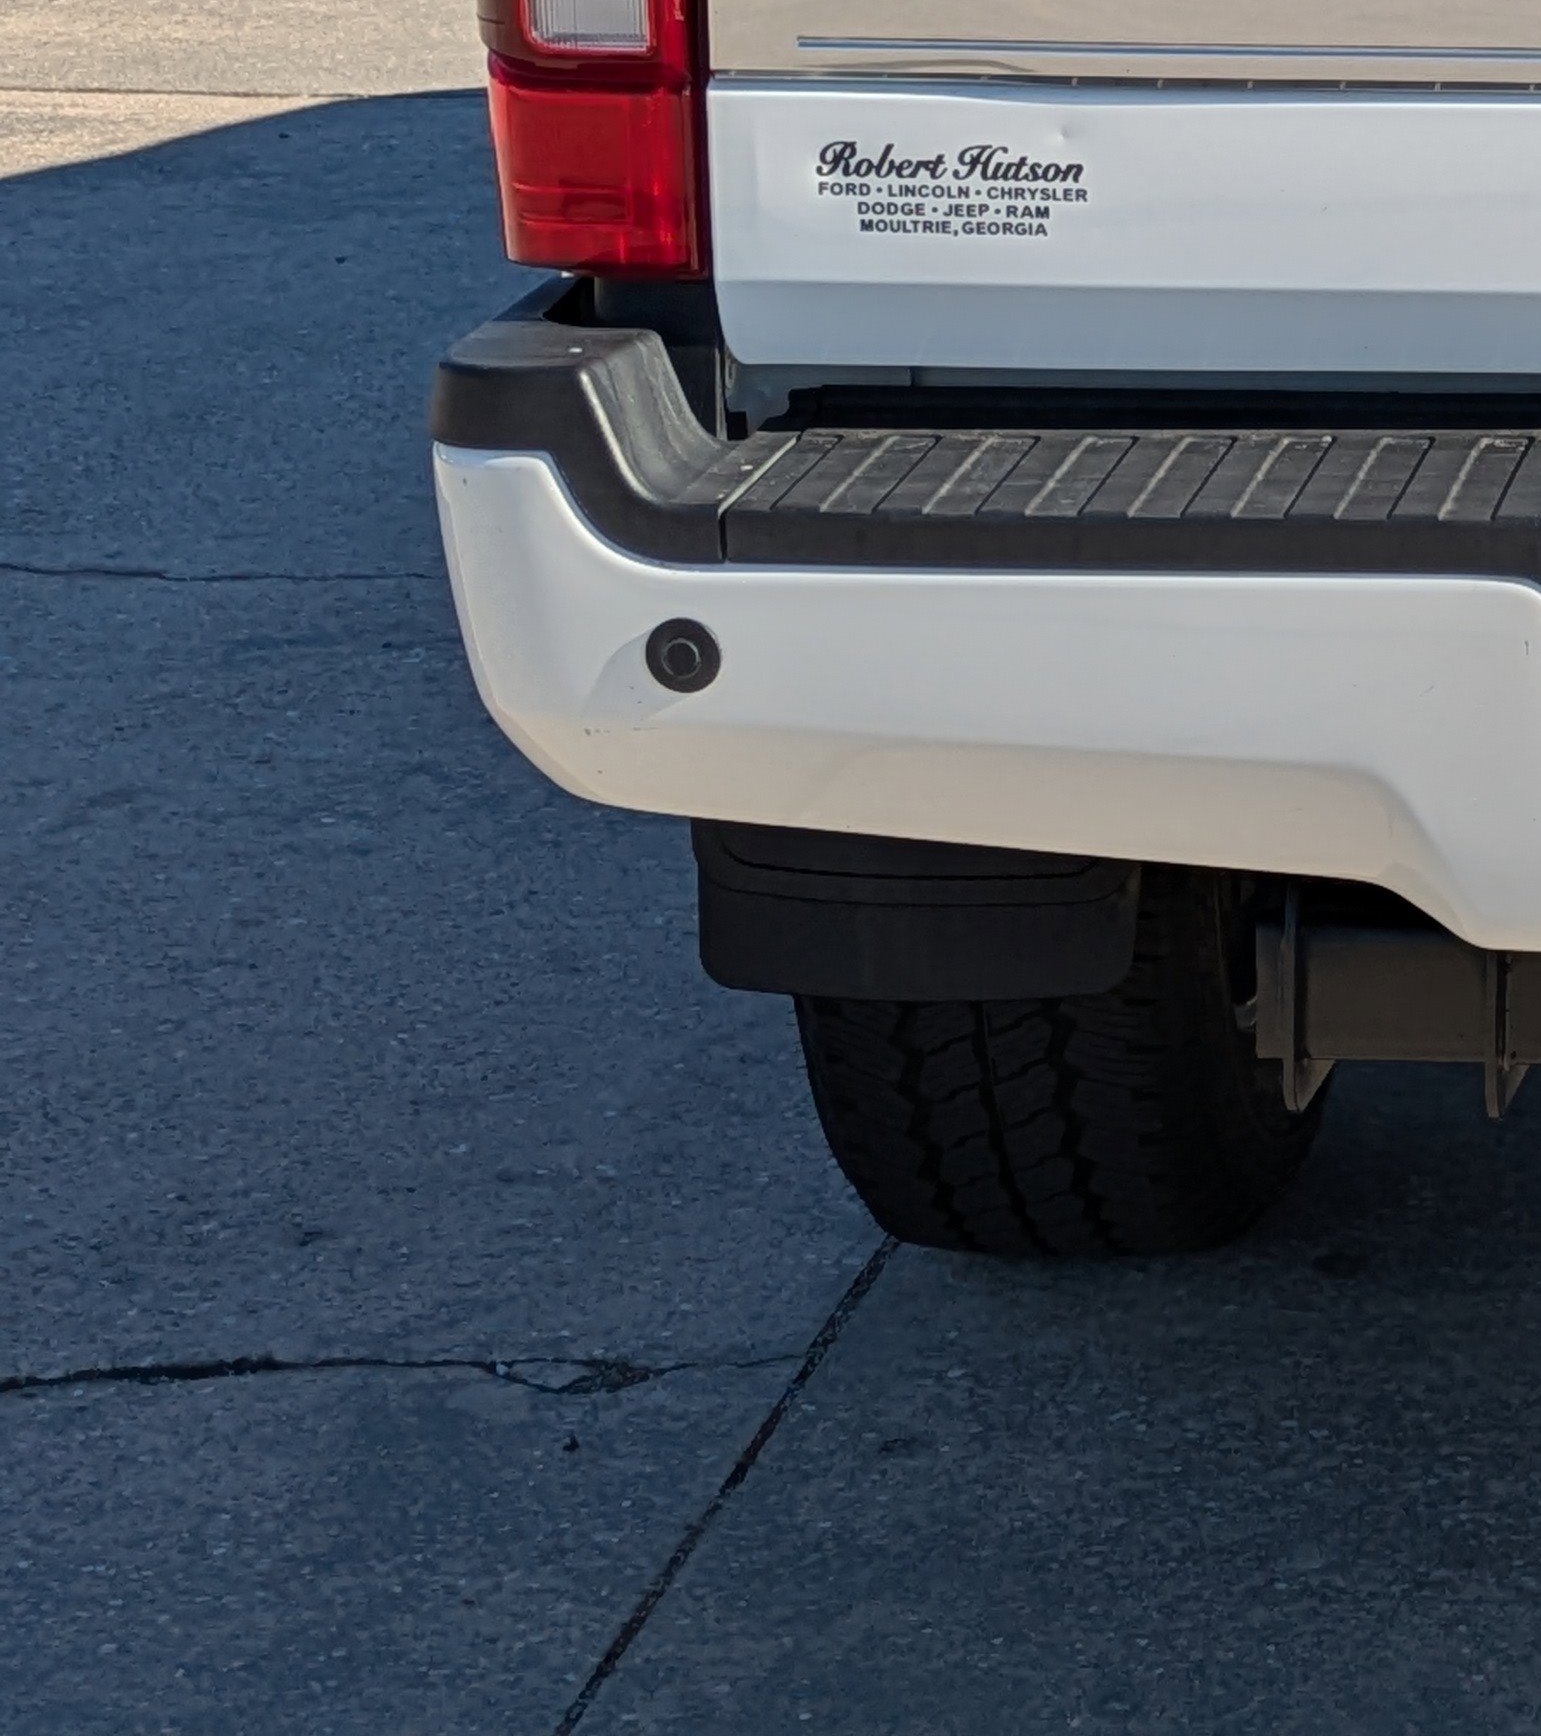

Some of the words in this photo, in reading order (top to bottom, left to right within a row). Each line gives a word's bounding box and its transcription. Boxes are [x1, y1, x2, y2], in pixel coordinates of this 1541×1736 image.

[815, 140, 948, 180] Robert
[952, 144, 1084, 184] Hutson
[818, 181, 871, 196] FORD
[887, 184, 970, 199] LINCOLN
[986, 186, 1088, 202] CHRYSLER
[857, 201, 926, 216] DODGE
[942, 203, 989, 217] JEEP
[1006, 205, 1050, 219] RAM
[962, 221, 1048, 236] GEORGIA
